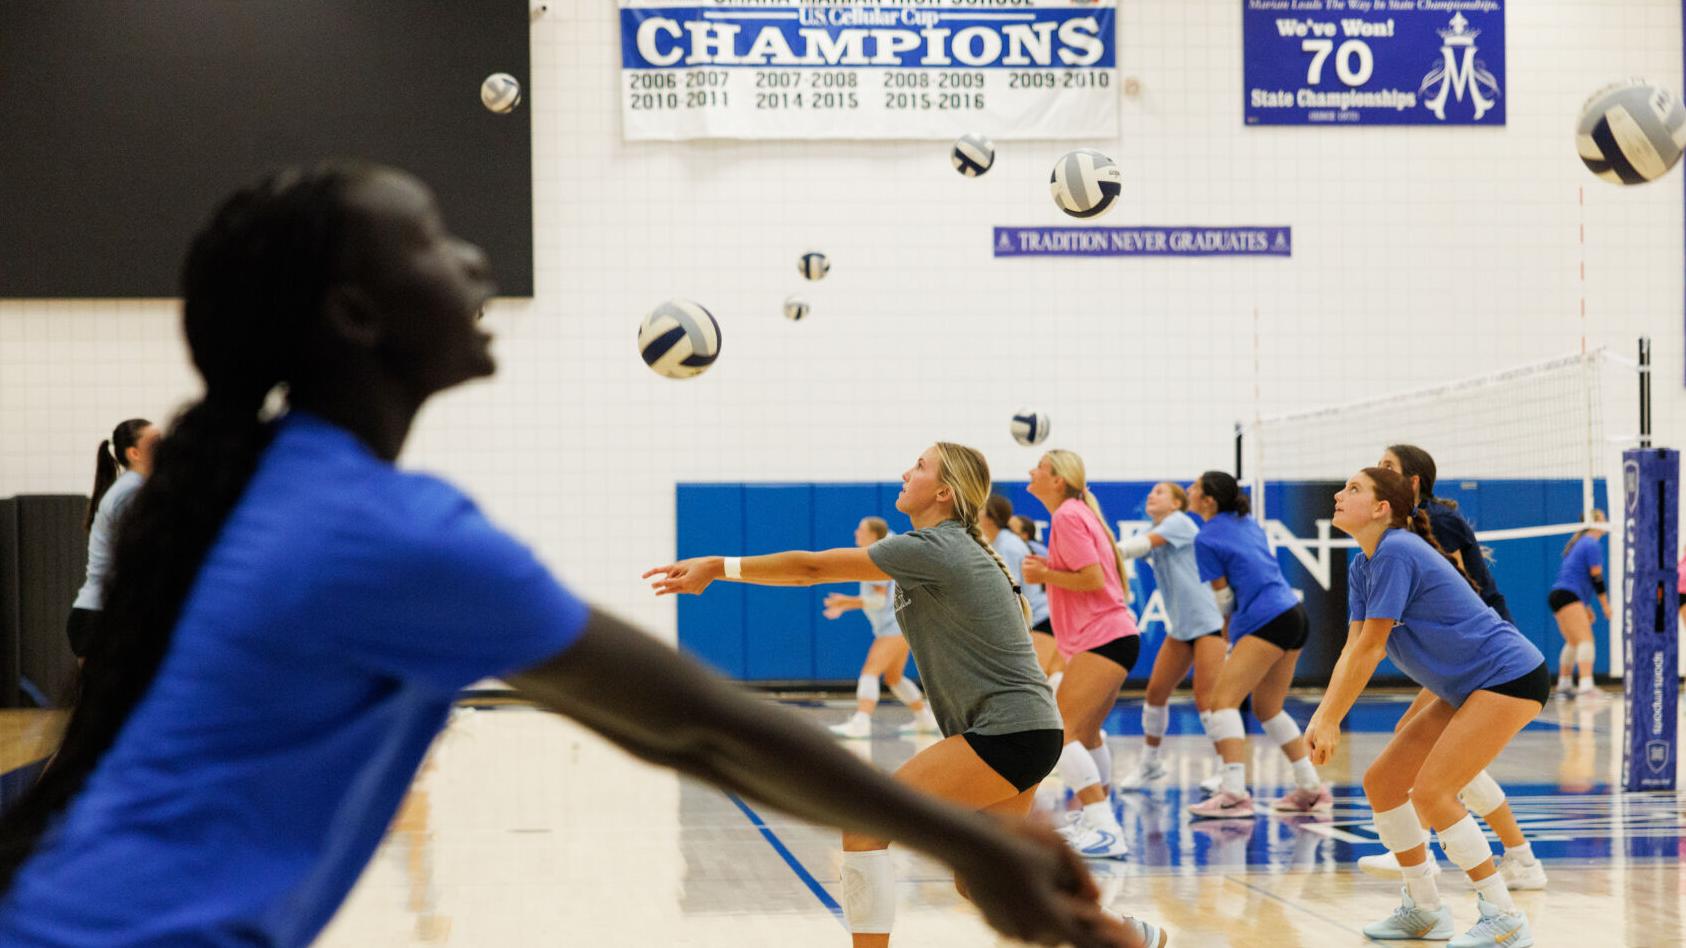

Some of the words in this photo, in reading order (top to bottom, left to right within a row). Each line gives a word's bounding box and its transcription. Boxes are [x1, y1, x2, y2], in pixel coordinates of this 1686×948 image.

[827, 6, 899, 26] Cellular
[900, 6, 940, 30] Cup
[1276, 18, 1337, 37] We've
[1340, 18, 1395, 37] Won!
[636, 16, 1104, 66] CHAMPIONS
[1301, 39, 1374, 86] 70
[1251, 88, 1295, 108] State
[1296, 88, 1417, 111] Championships
[1017, 231, 1109, 251] TRADITION
[1111, 231, 1167, 251] NEVER
[1169, 231, 1269, 251] GRADUATES
